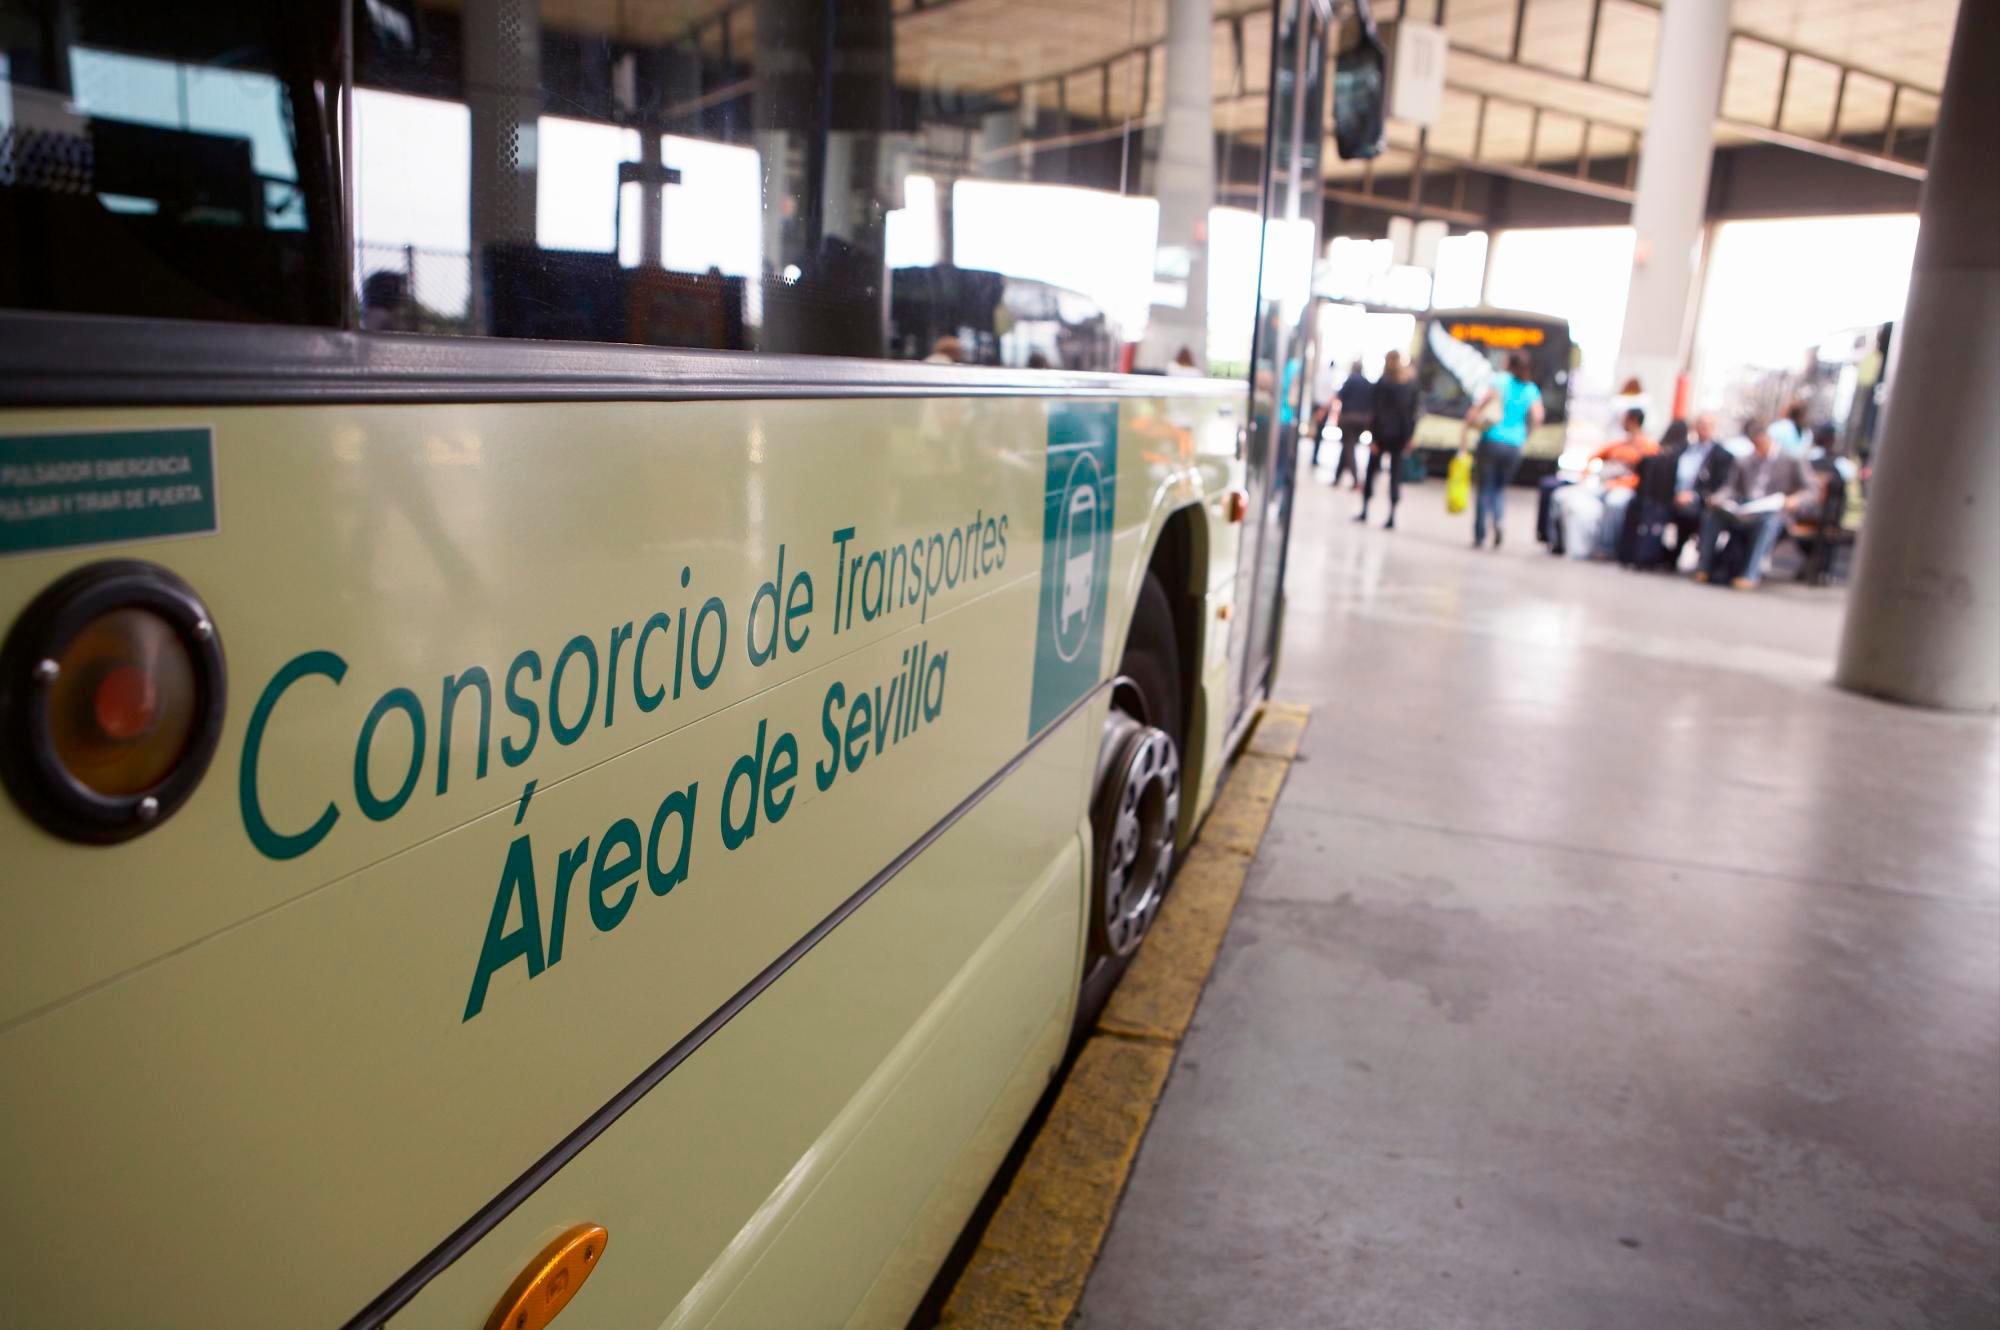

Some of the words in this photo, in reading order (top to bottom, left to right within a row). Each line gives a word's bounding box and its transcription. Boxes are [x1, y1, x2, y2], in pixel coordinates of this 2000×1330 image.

[1, 460, 91, 487] PULSADOR
[96, 455, 191, 481] EMERGENCIA
[63, 492, 74, 513] Y
[76, 490, 121, 513] TIRAR
[125, 489, 144, 509] DE
[148, 484, 203, 506] PUERTA
[239, 565, 728, 861] Consorcio
[747, 543, 814, 666] de
[832, 509, 1008, 635] Transportes
[462, 780, 698, 1022] Área
[720, 718, 798, 851] de
[815, 640, 949, 791] Sevilla
